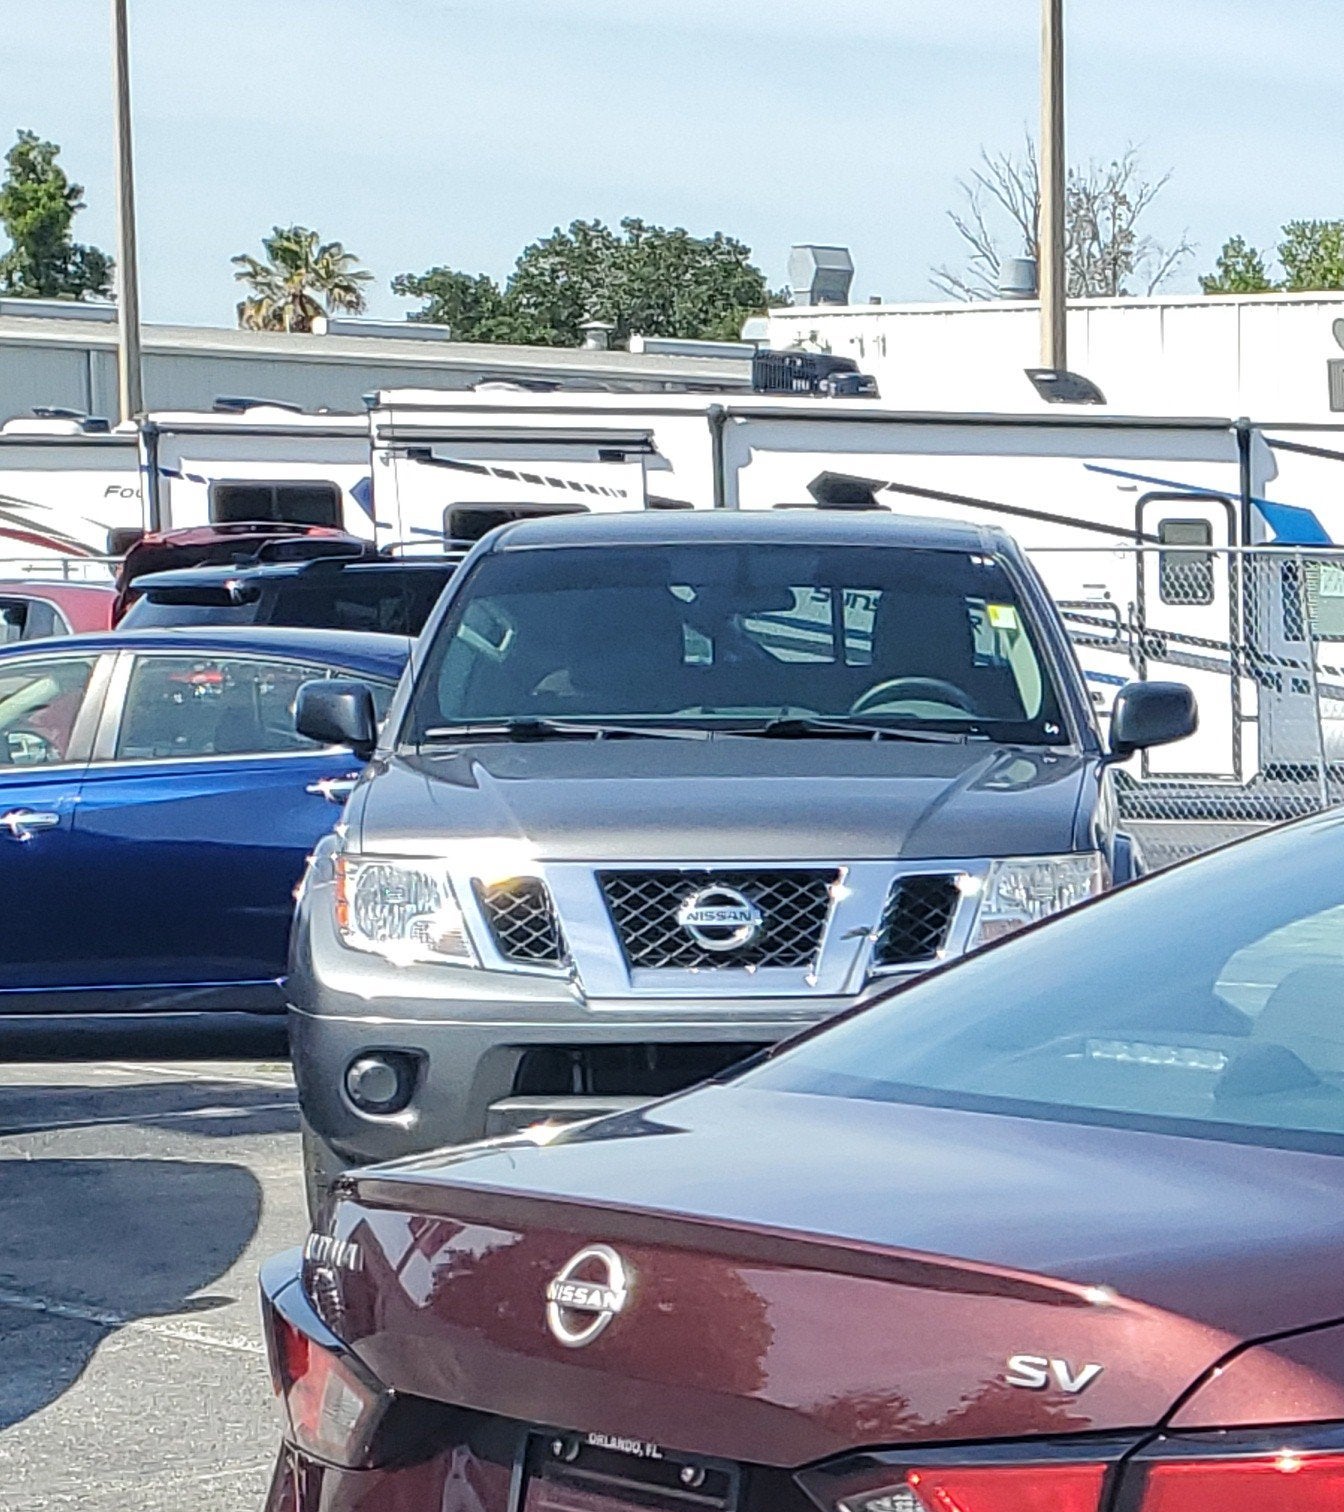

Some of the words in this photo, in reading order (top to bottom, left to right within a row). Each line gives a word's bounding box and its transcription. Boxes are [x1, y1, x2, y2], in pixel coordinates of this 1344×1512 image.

[687, 910, 752, 922] NISSAN
[547, 1282, 627, 1312] NISSAN
[1005, 1354, 1102, 1393] SV
